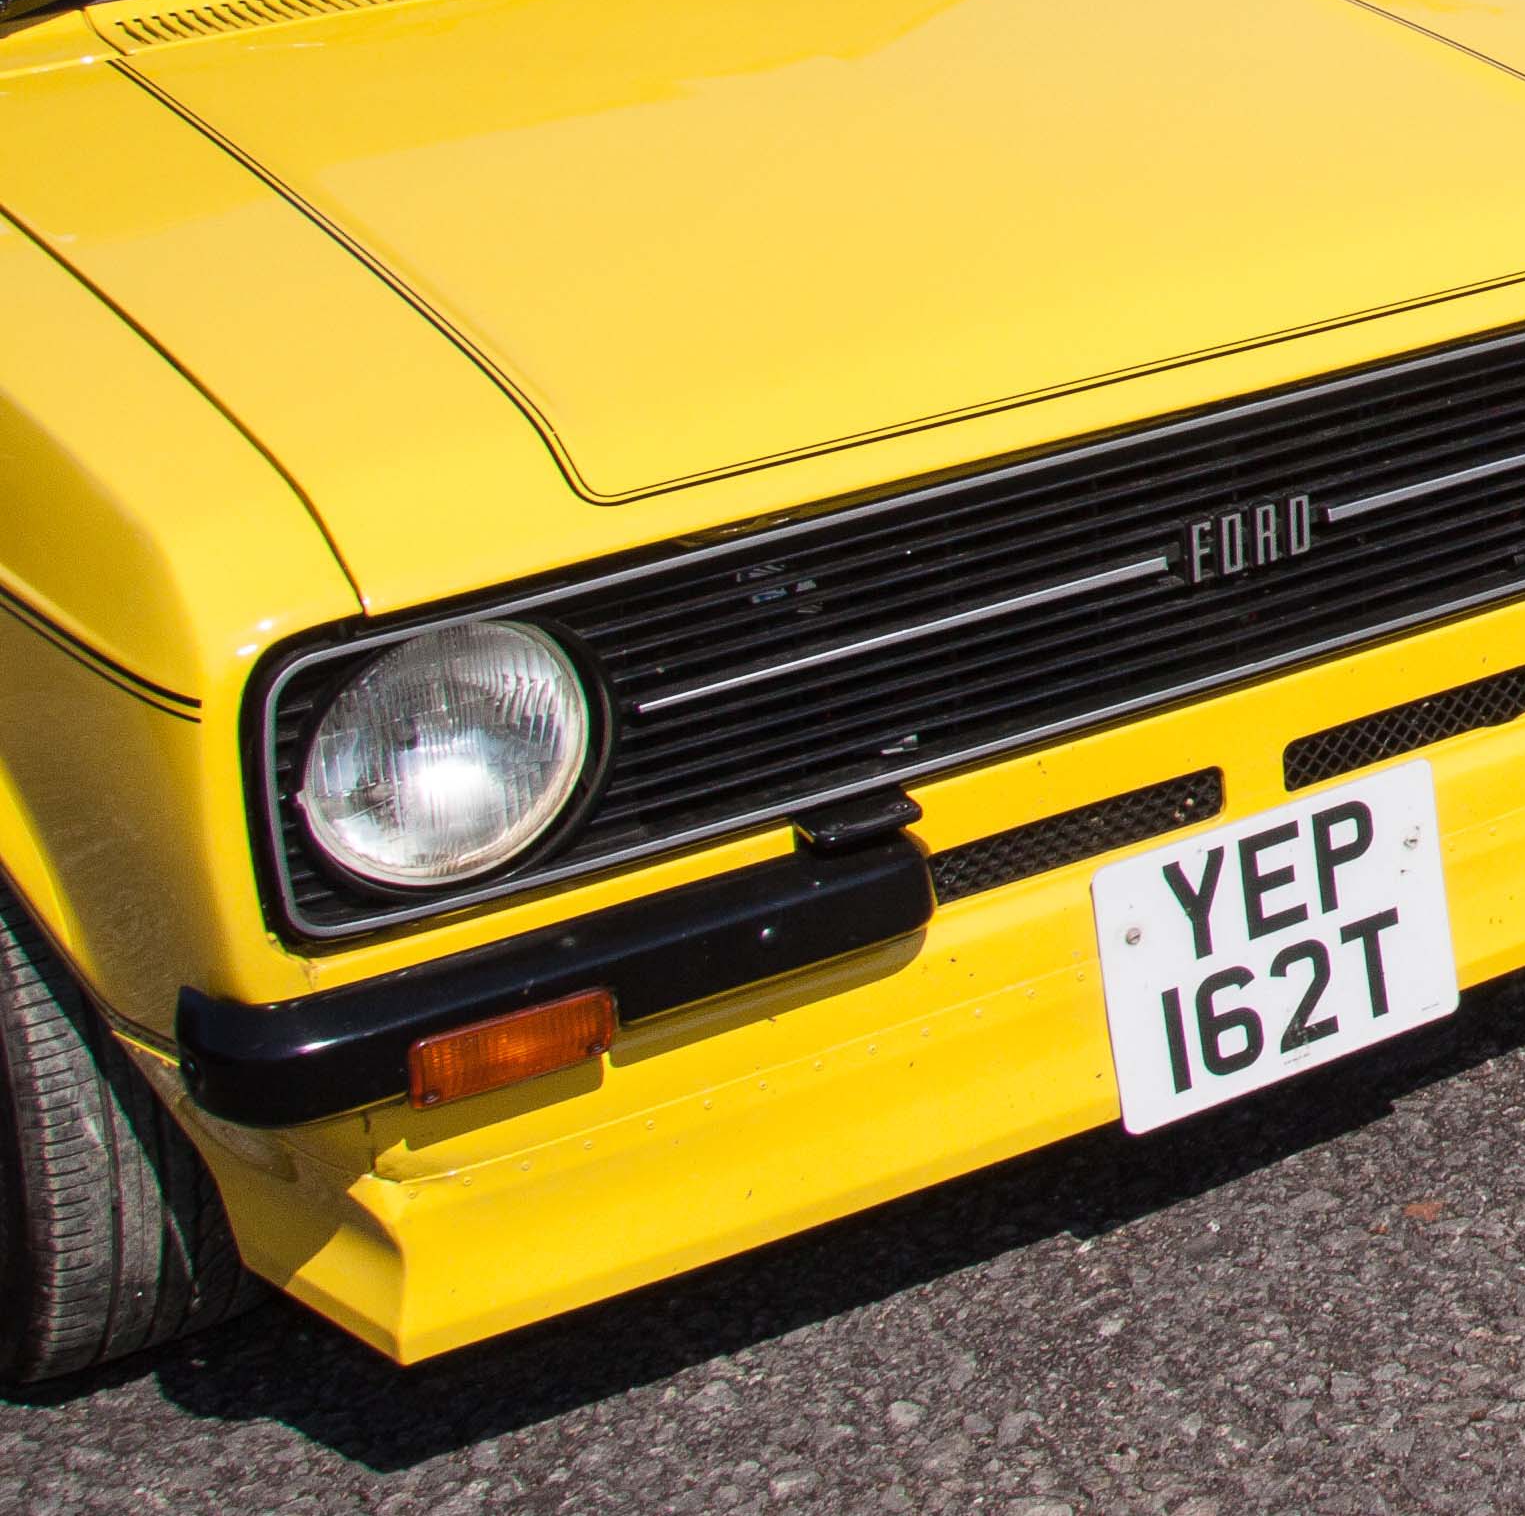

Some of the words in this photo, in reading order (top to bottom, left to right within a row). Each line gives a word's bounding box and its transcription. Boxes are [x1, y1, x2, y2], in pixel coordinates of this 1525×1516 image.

[1190, 493, 1312, 584] FORD
[1162, 800, 1374, 960] YEP
[1161, 906, 1399, 1094] 162T
